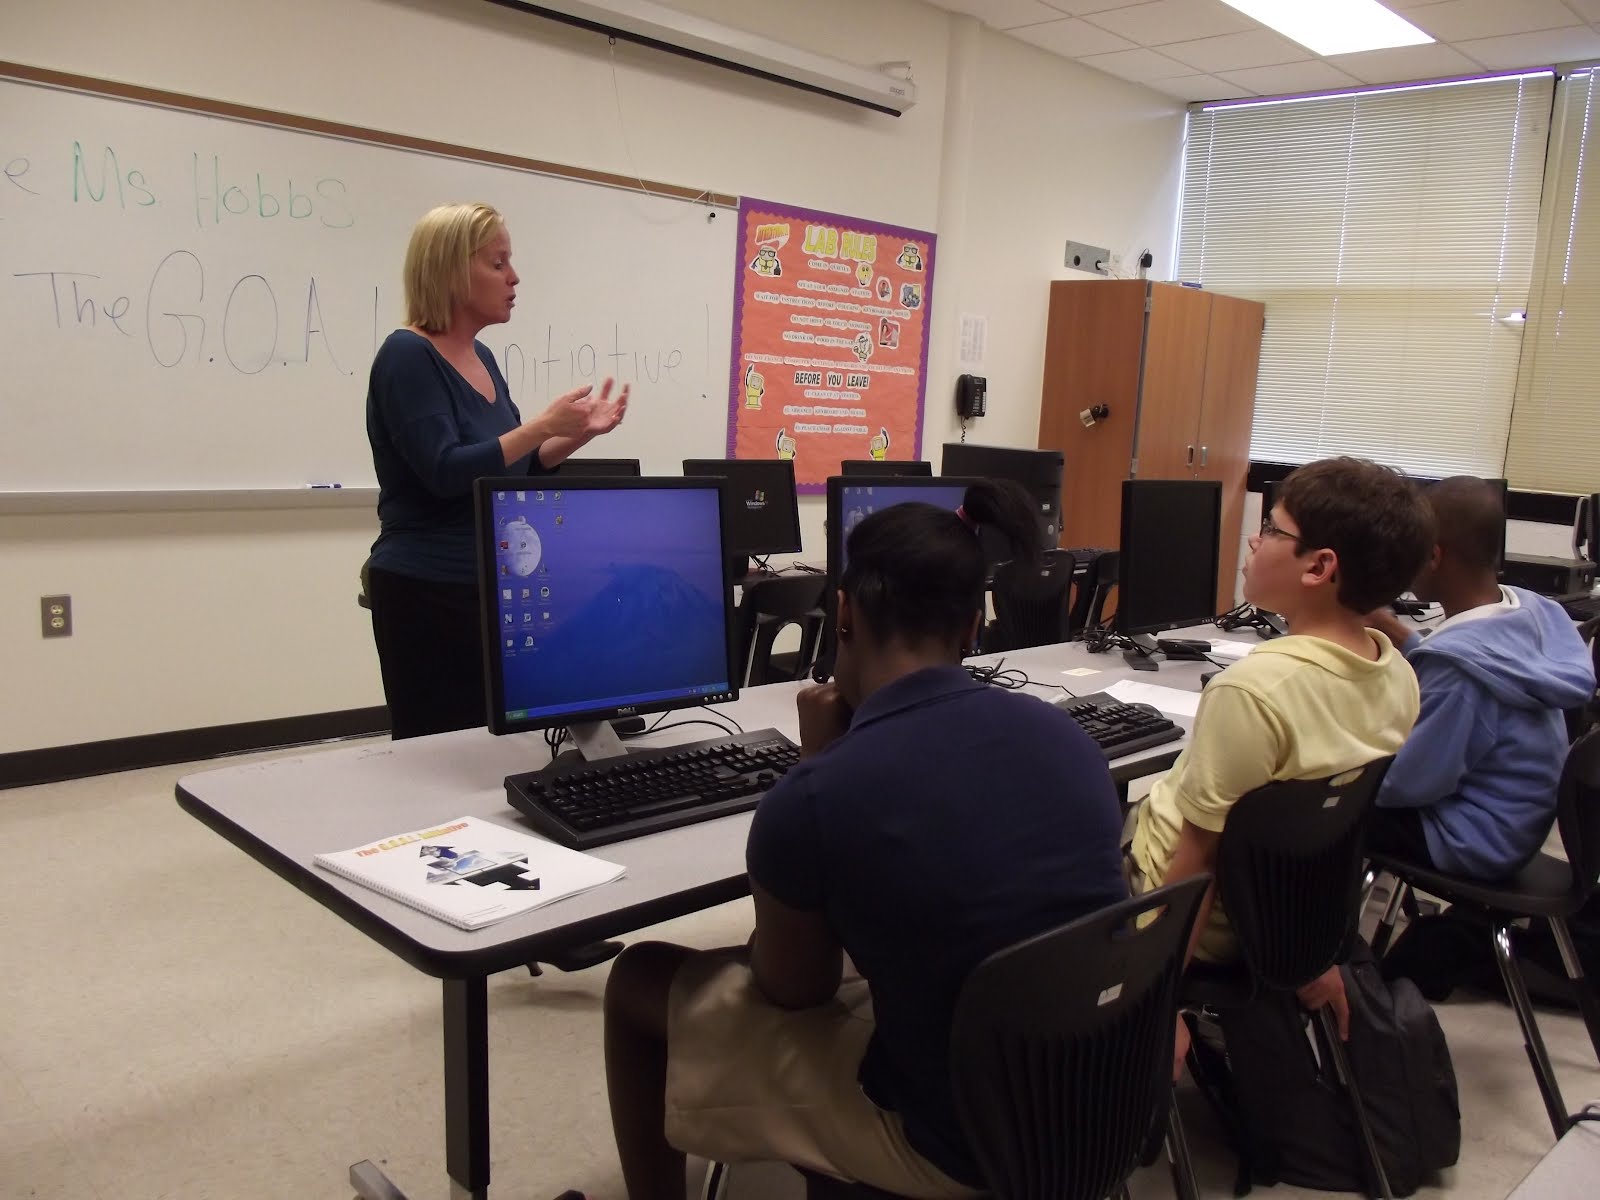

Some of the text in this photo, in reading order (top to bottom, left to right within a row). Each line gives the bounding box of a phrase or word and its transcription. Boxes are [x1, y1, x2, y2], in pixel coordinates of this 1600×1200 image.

[805, 225, 876, 261] LAB RULES
[14, 271, 132, 338] The
[503, 304, 712, 399] nitiative!
[794, 372, 869, 388] BEFORE YOU LEAVE!
[617, 706, 637, 716] DELL
[354, 847, 380, 858] The
